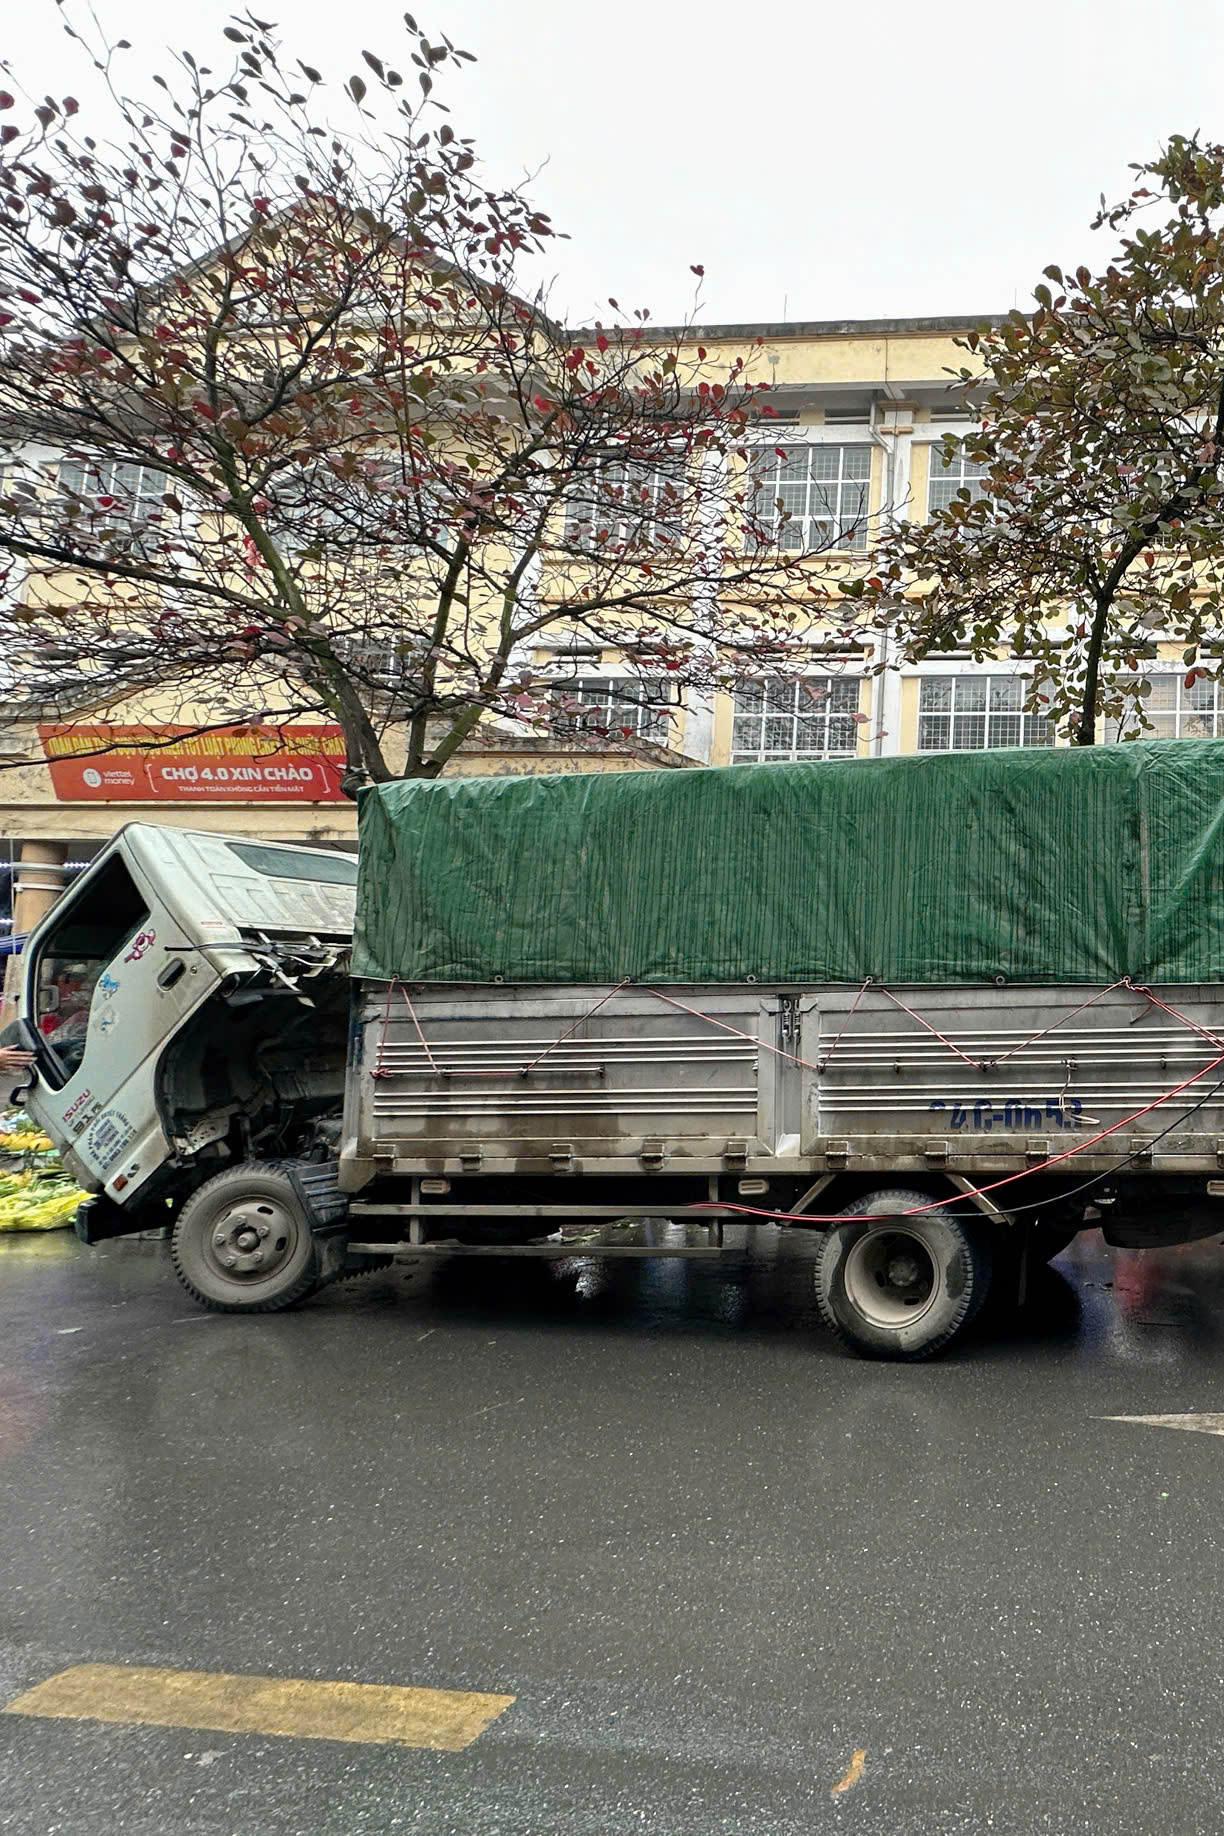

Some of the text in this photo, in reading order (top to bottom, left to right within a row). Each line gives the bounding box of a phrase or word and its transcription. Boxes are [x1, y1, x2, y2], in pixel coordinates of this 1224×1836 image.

[201, 733, 225, 759] LUẬT
[103, 778, 135, 786] money
[161, 763, 313, 783] CHỢ 4.0 XIN CHÀO
[62, 1089, 91, 1122] ISUZU
